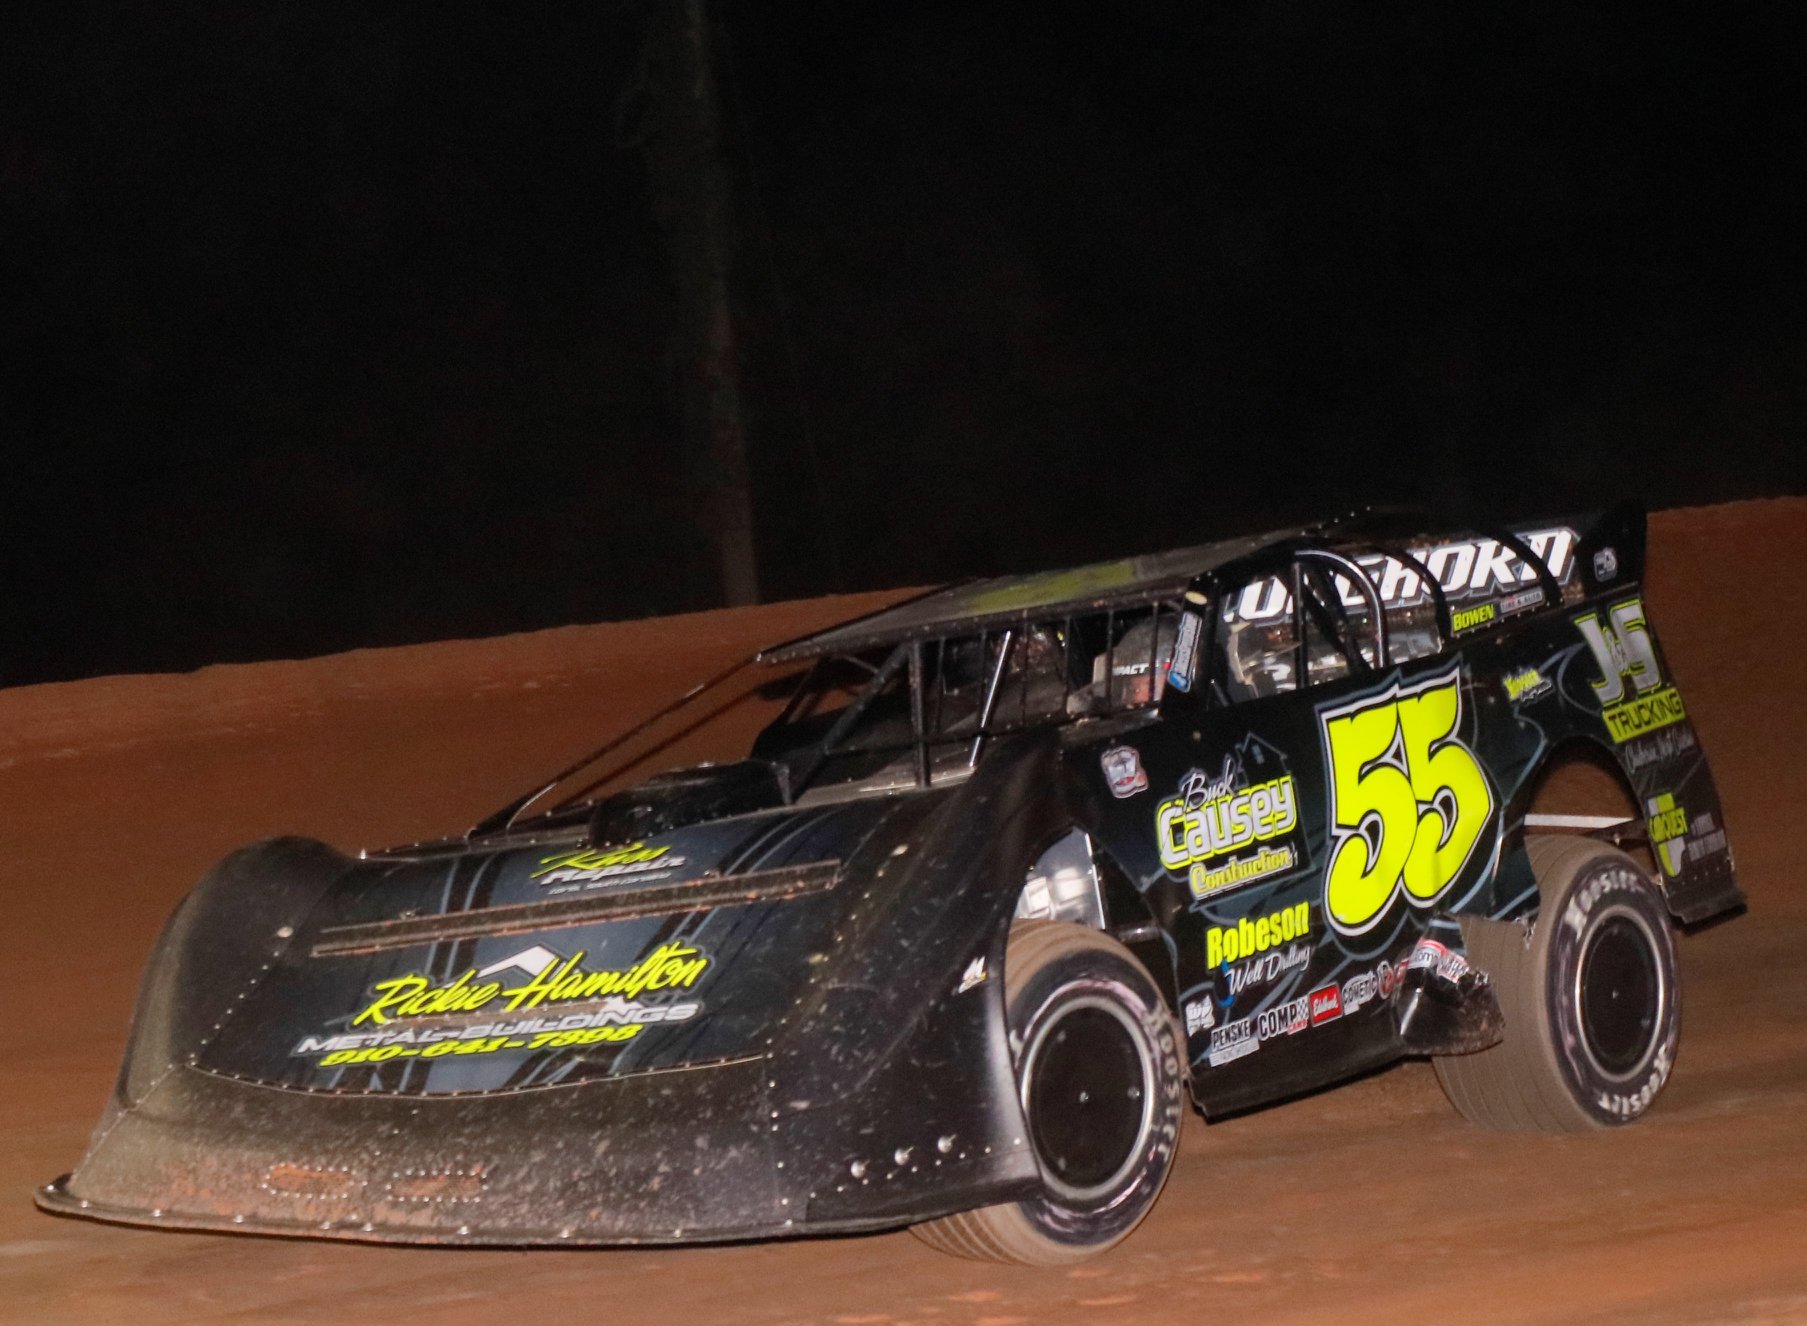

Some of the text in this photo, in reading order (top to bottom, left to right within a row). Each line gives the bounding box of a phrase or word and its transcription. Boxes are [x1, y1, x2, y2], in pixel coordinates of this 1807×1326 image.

[1453, 603, 1495, 633] BOWEN
[1608, 692, 1682, 738] TRUCKING
[1181, 759, 1235, 811] Buck
[1321, 666, 1495, 937] 55
[1156, 774, 1297, 870] Causey
[540, 855, 686, 886] Repair
[1189, 850, 1294, 899] Construction
[1206, 901, 1311, 970] Robeson
[352, 942, 707, 1027] Rickie Hamilton
[1224, 961, 1263, 996] Well
[1211, 1020, 1250, 1050] PENSKE
[1257, 1000, 1298, 1041] COMP
